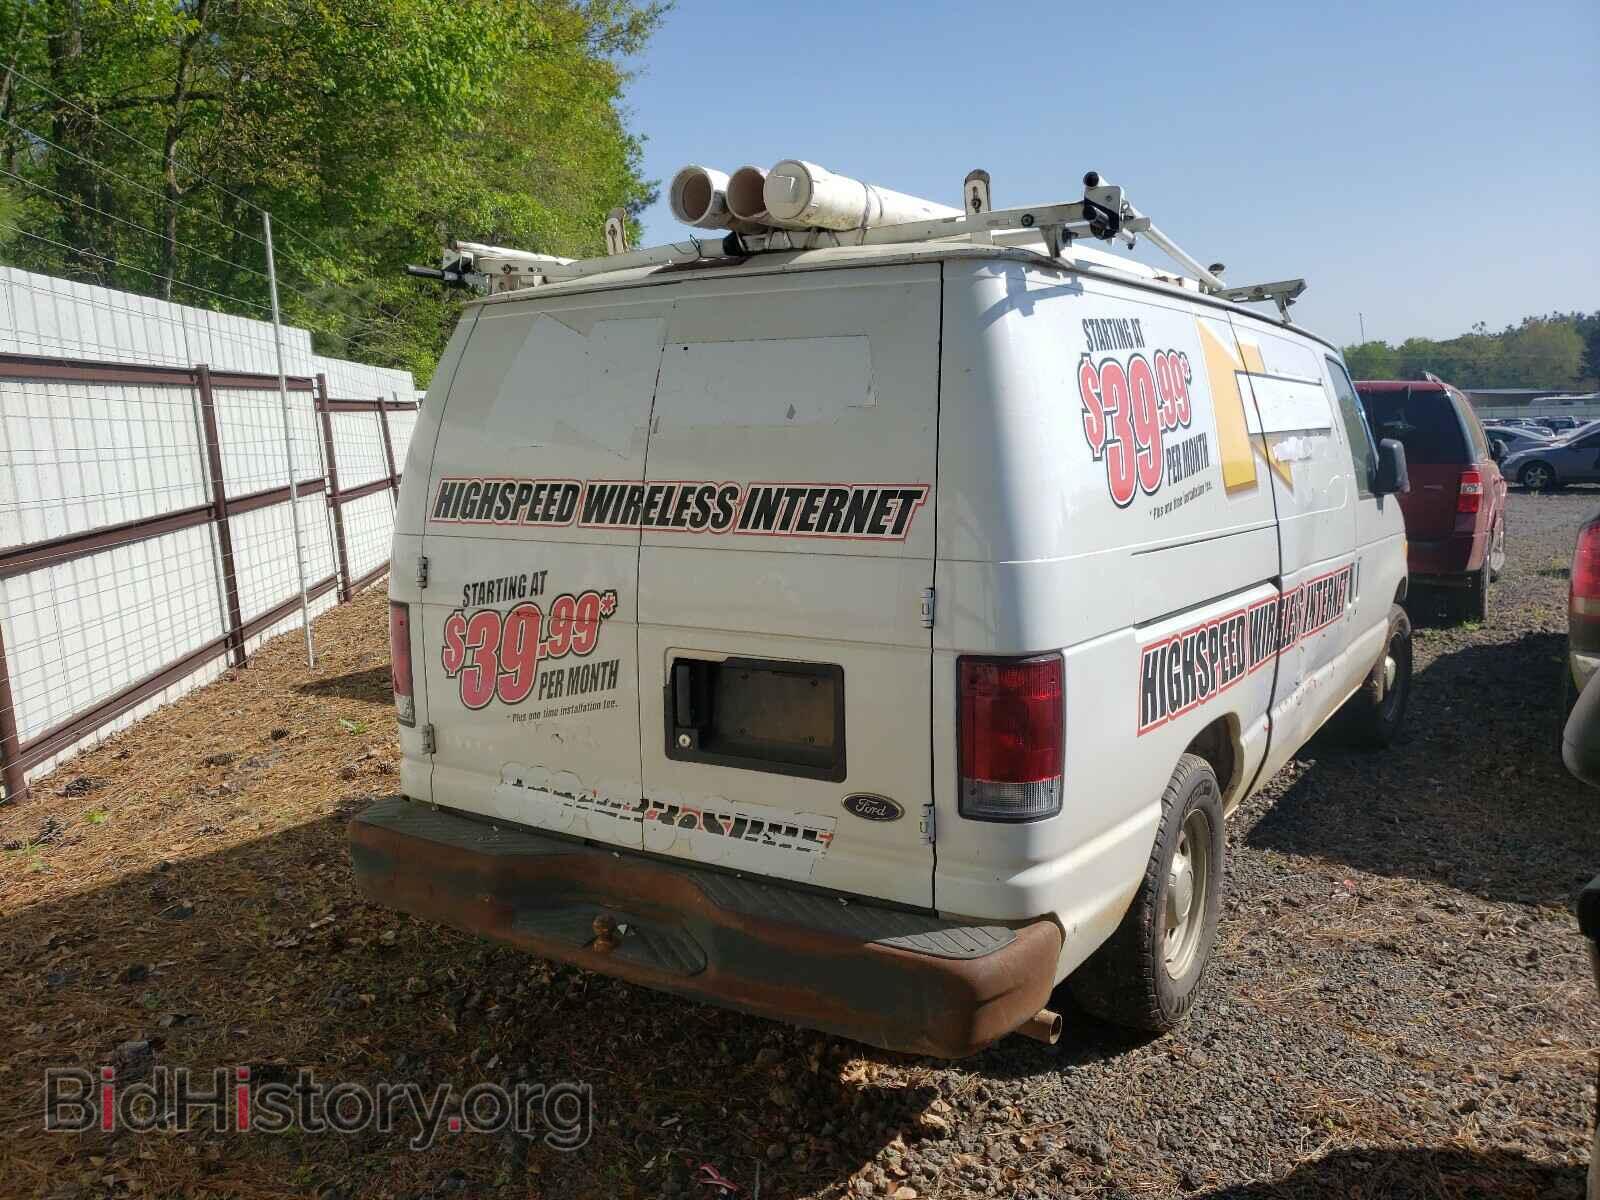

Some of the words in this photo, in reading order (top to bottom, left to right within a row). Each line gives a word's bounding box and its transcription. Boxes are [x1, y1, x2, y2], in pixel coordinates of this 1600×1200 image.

[1082, 318, 1134, 352] STARTING
[1131, 318, 1145, 348] AT
[1166, 445, 1183, 486] PER
[1181, 432, 1210, 478] MONTH
[433, 478, 580, 525] HIGHSPEED
[579, 481, 738, 533] WIRELESS
[736, 483, 927, 538] INTERNET
[463, 573, 527, 607] STARTING
[529, 570, 548, 596] AT
[1139, 610, 1248, 733] HIGHSPEED
[1248, 585, 1304, 671] WIRELESS
[538, 669, 564, 700] PER
[566, 659, 620, 696] MONTH
[560, 701, 601, 716] installation
[855, 798, 887, 816] Ford
